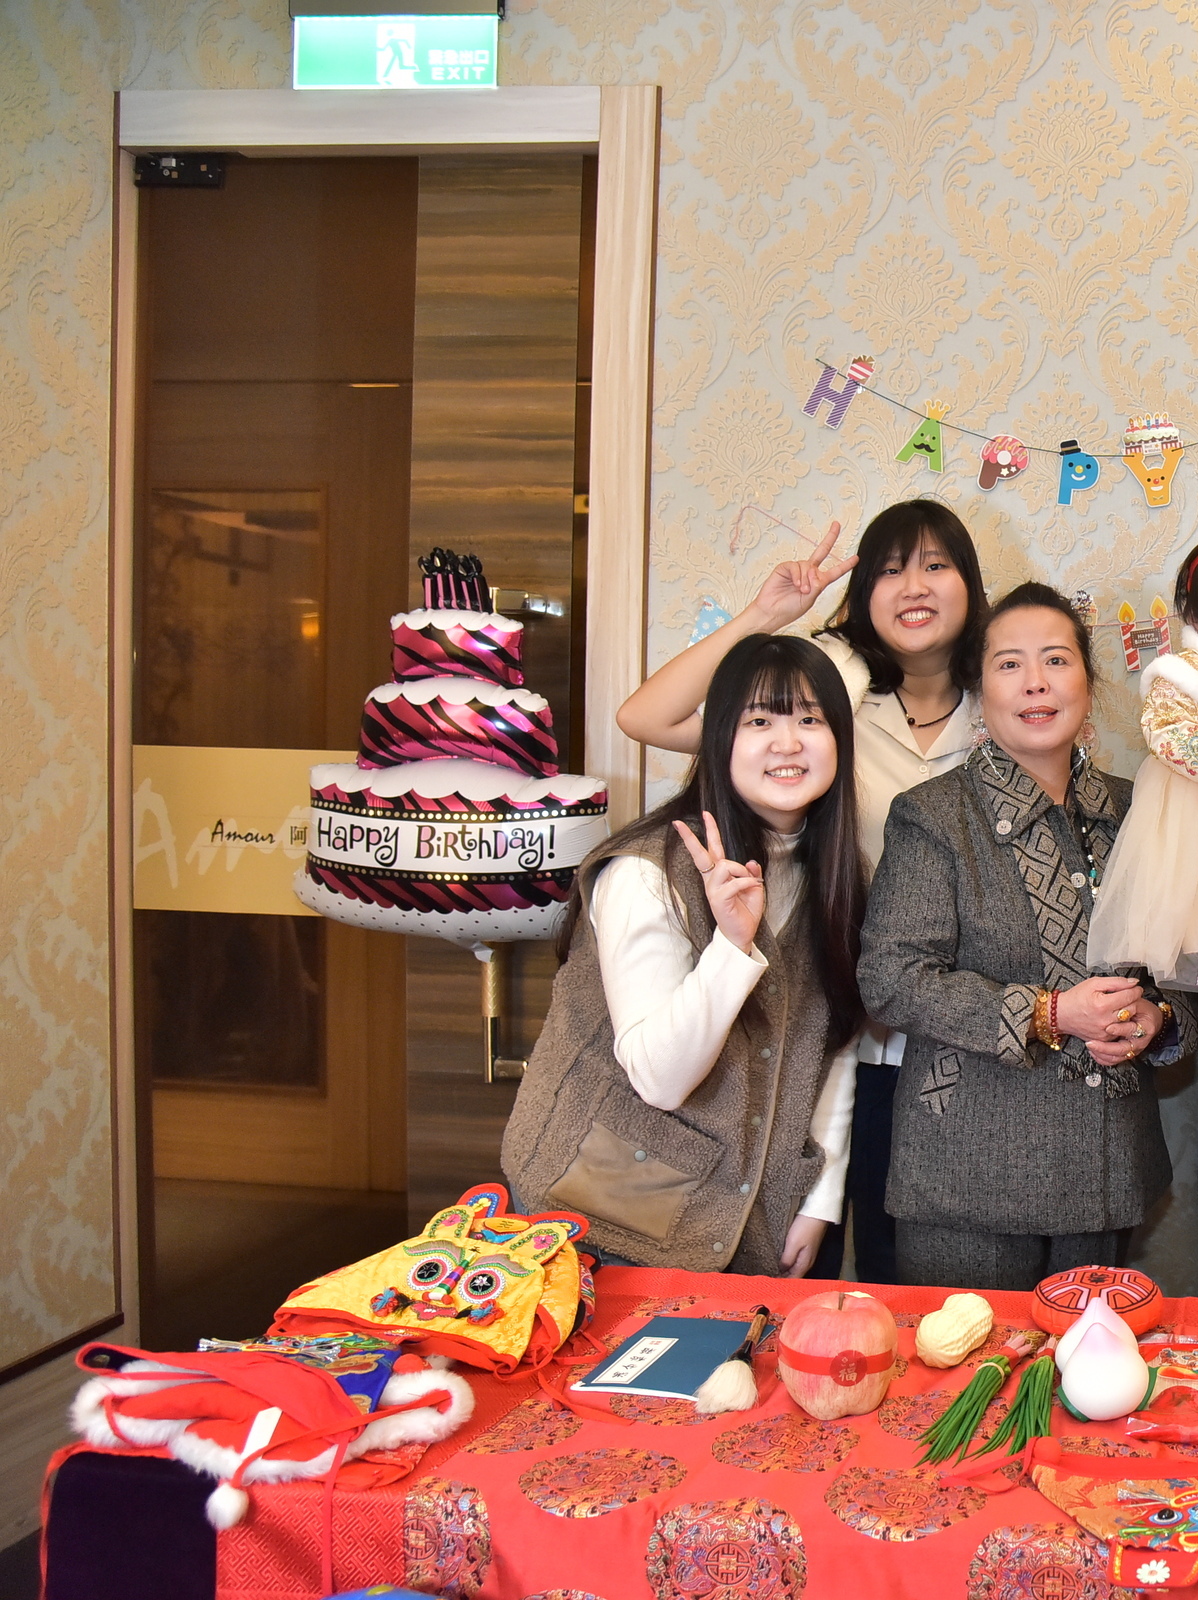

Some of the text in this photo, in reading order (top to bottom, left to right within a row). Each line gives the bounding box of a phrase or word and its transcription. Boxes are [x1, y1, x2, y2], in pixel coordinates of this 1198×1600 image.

[431, 67, 485, 80] EXIT
[210, 819, 276, 844] Amour
[317, 816, 400, 868] Happy
